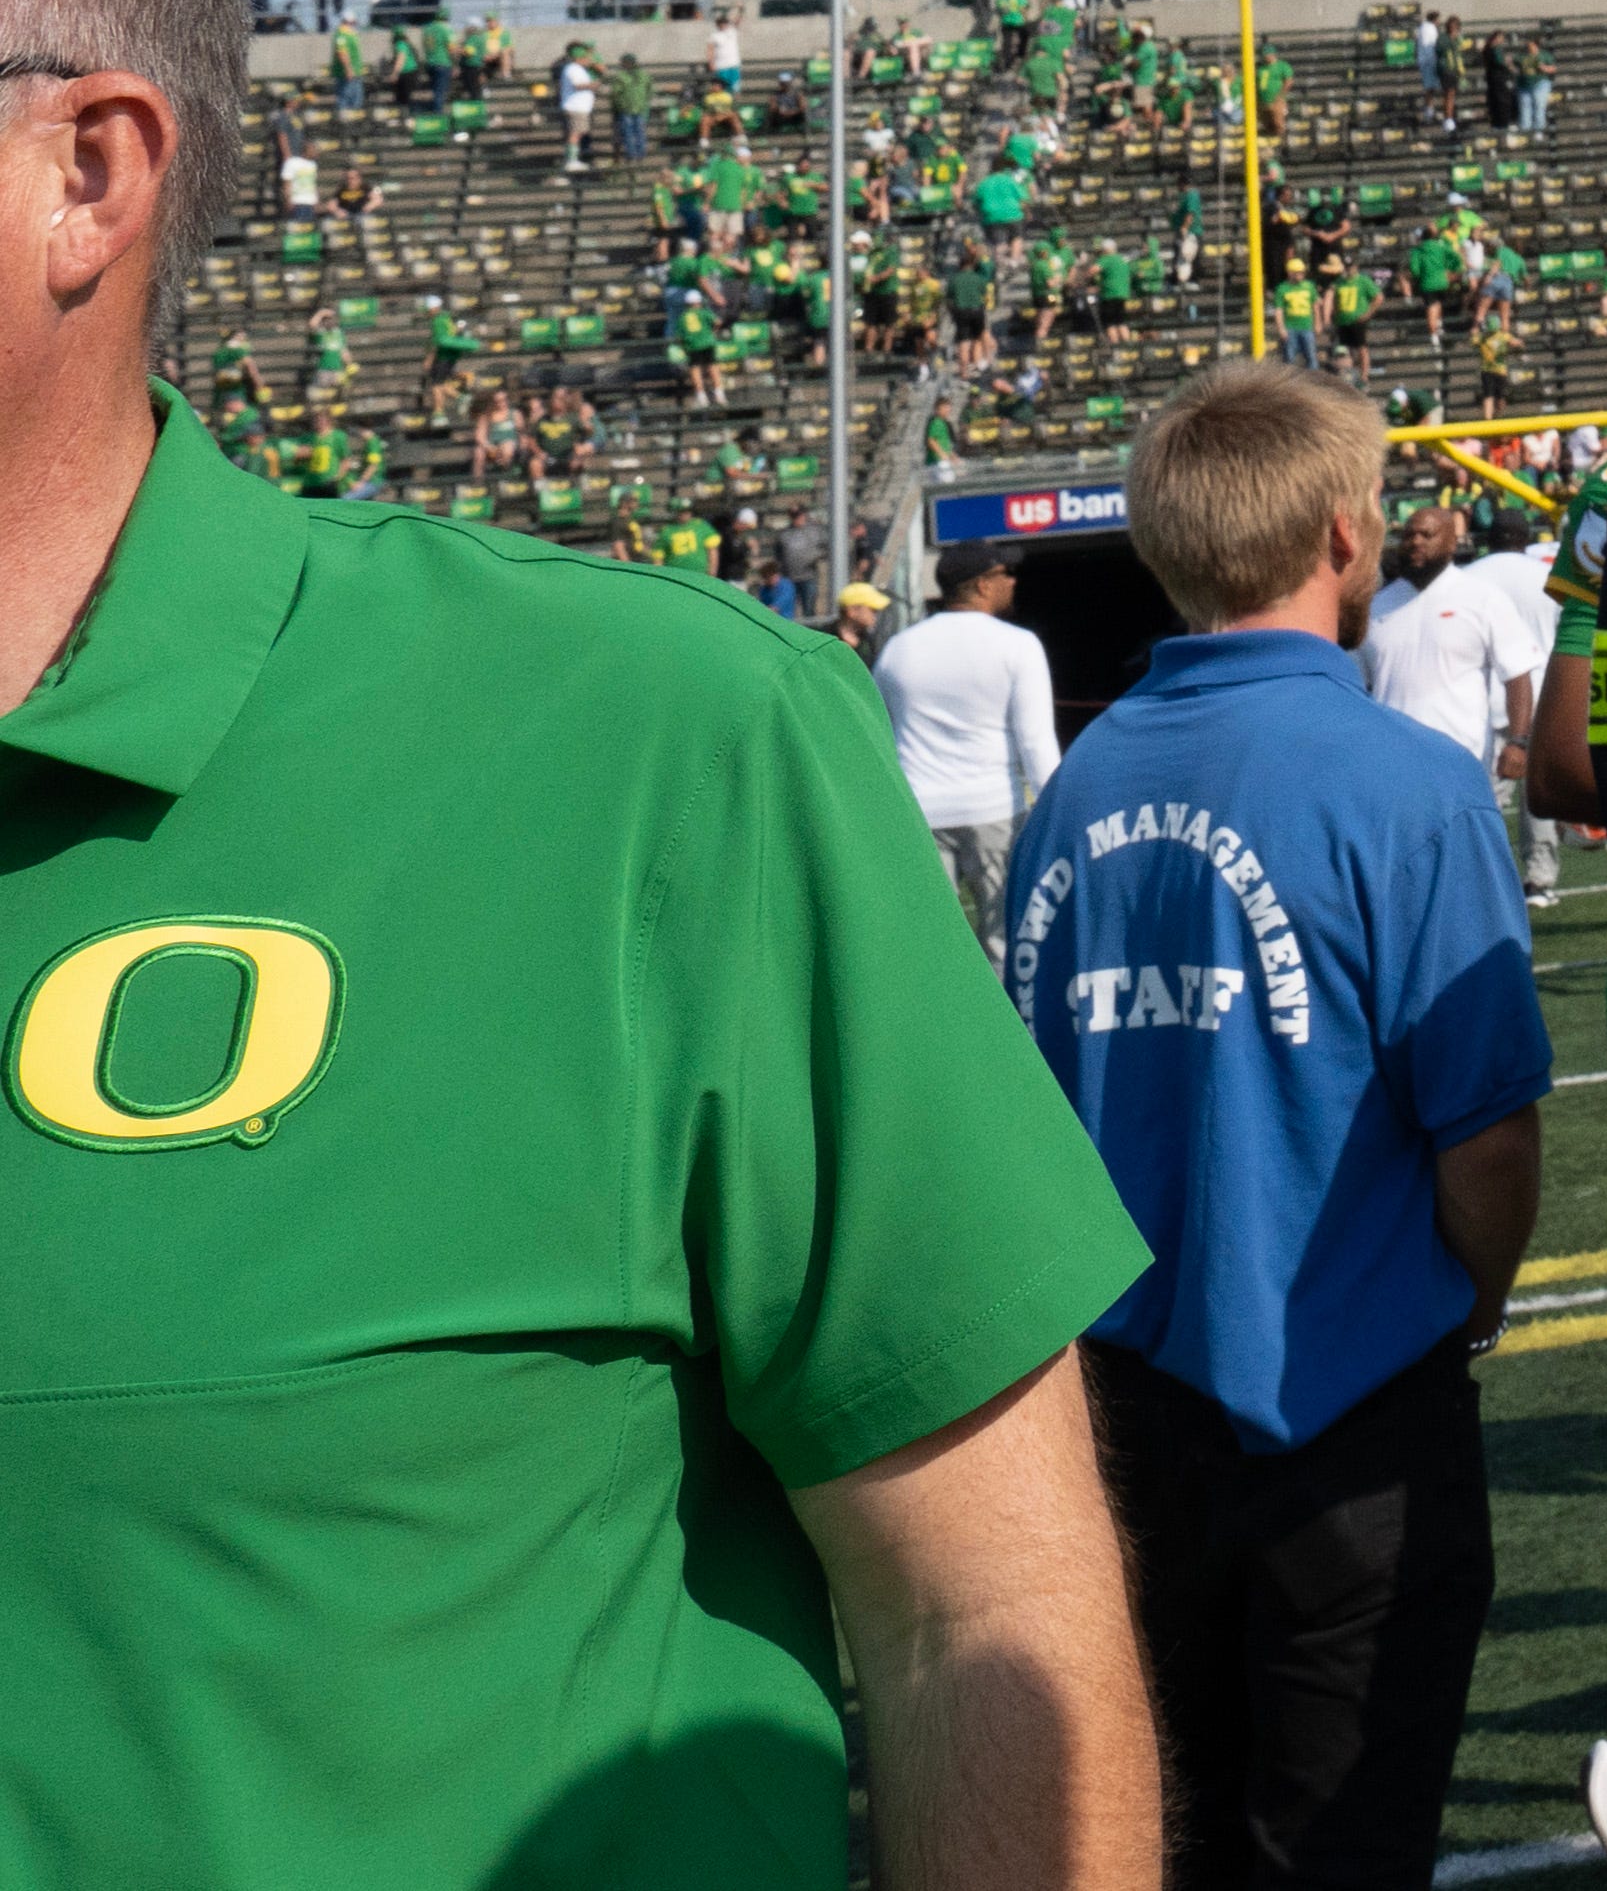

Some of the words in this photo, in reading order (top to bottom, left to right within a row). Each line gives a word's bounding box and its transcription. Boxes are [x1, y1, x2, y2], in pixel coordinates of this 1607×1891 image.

[1009, 498, 1055, 526] us
[1058, 489, 1127, 521] ban
[1086, 801, 1310, 1045] MANAGEMENT
